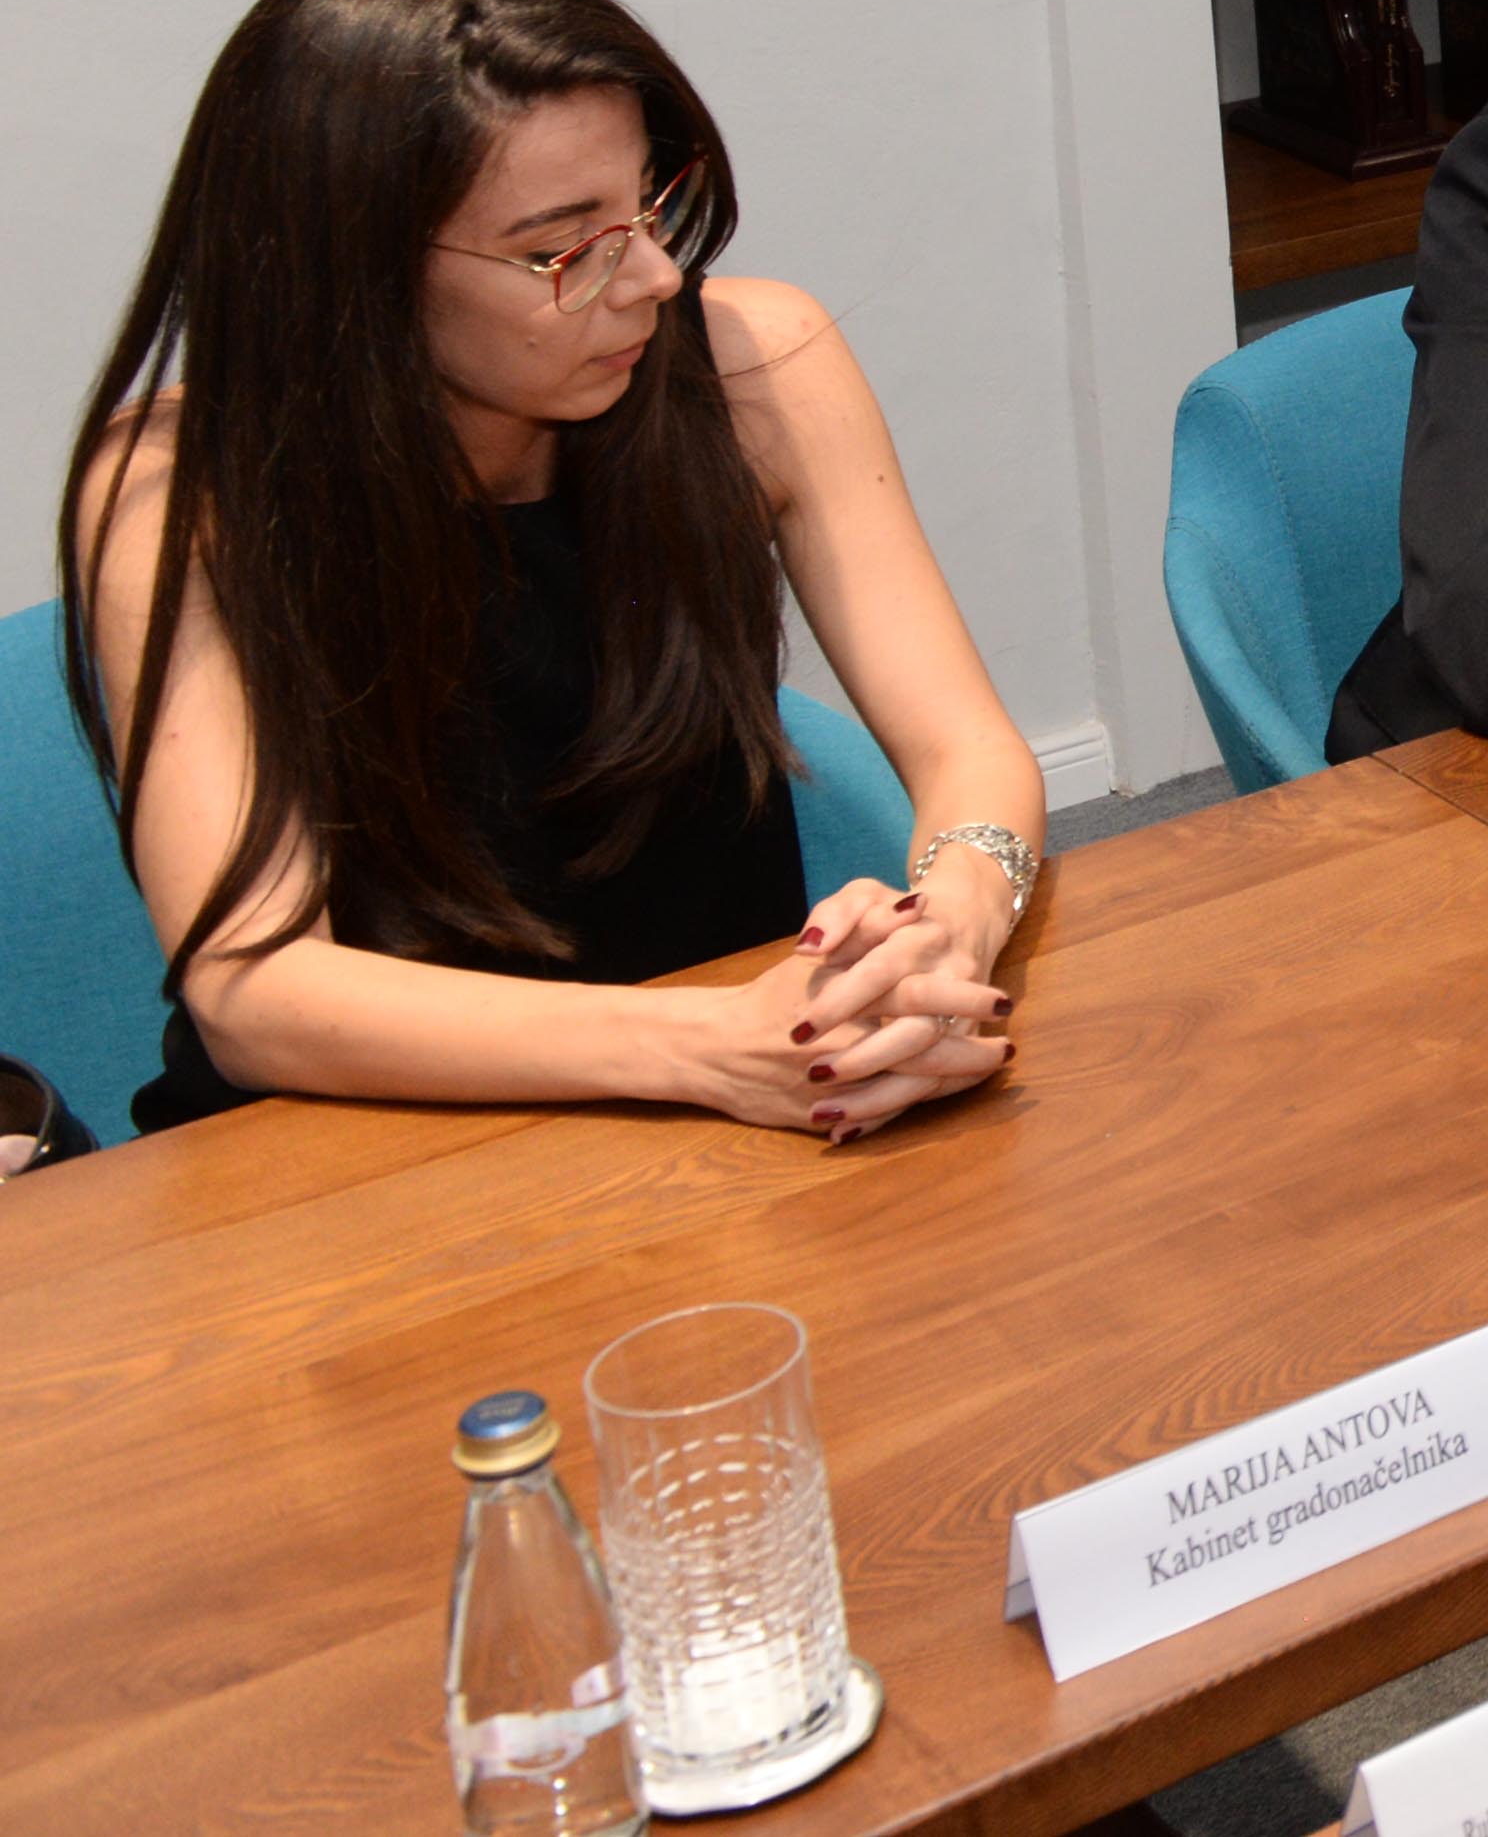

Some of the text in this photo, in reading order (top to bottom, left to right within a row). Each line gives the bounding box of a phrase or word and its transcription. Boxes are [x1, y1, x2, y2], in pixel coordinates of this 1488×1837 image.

[1145, 1430, 1470, 1588] Kabinet gradonačelnika
[1164, 1386, 1436, 1526] MARIJA ANTOVA
